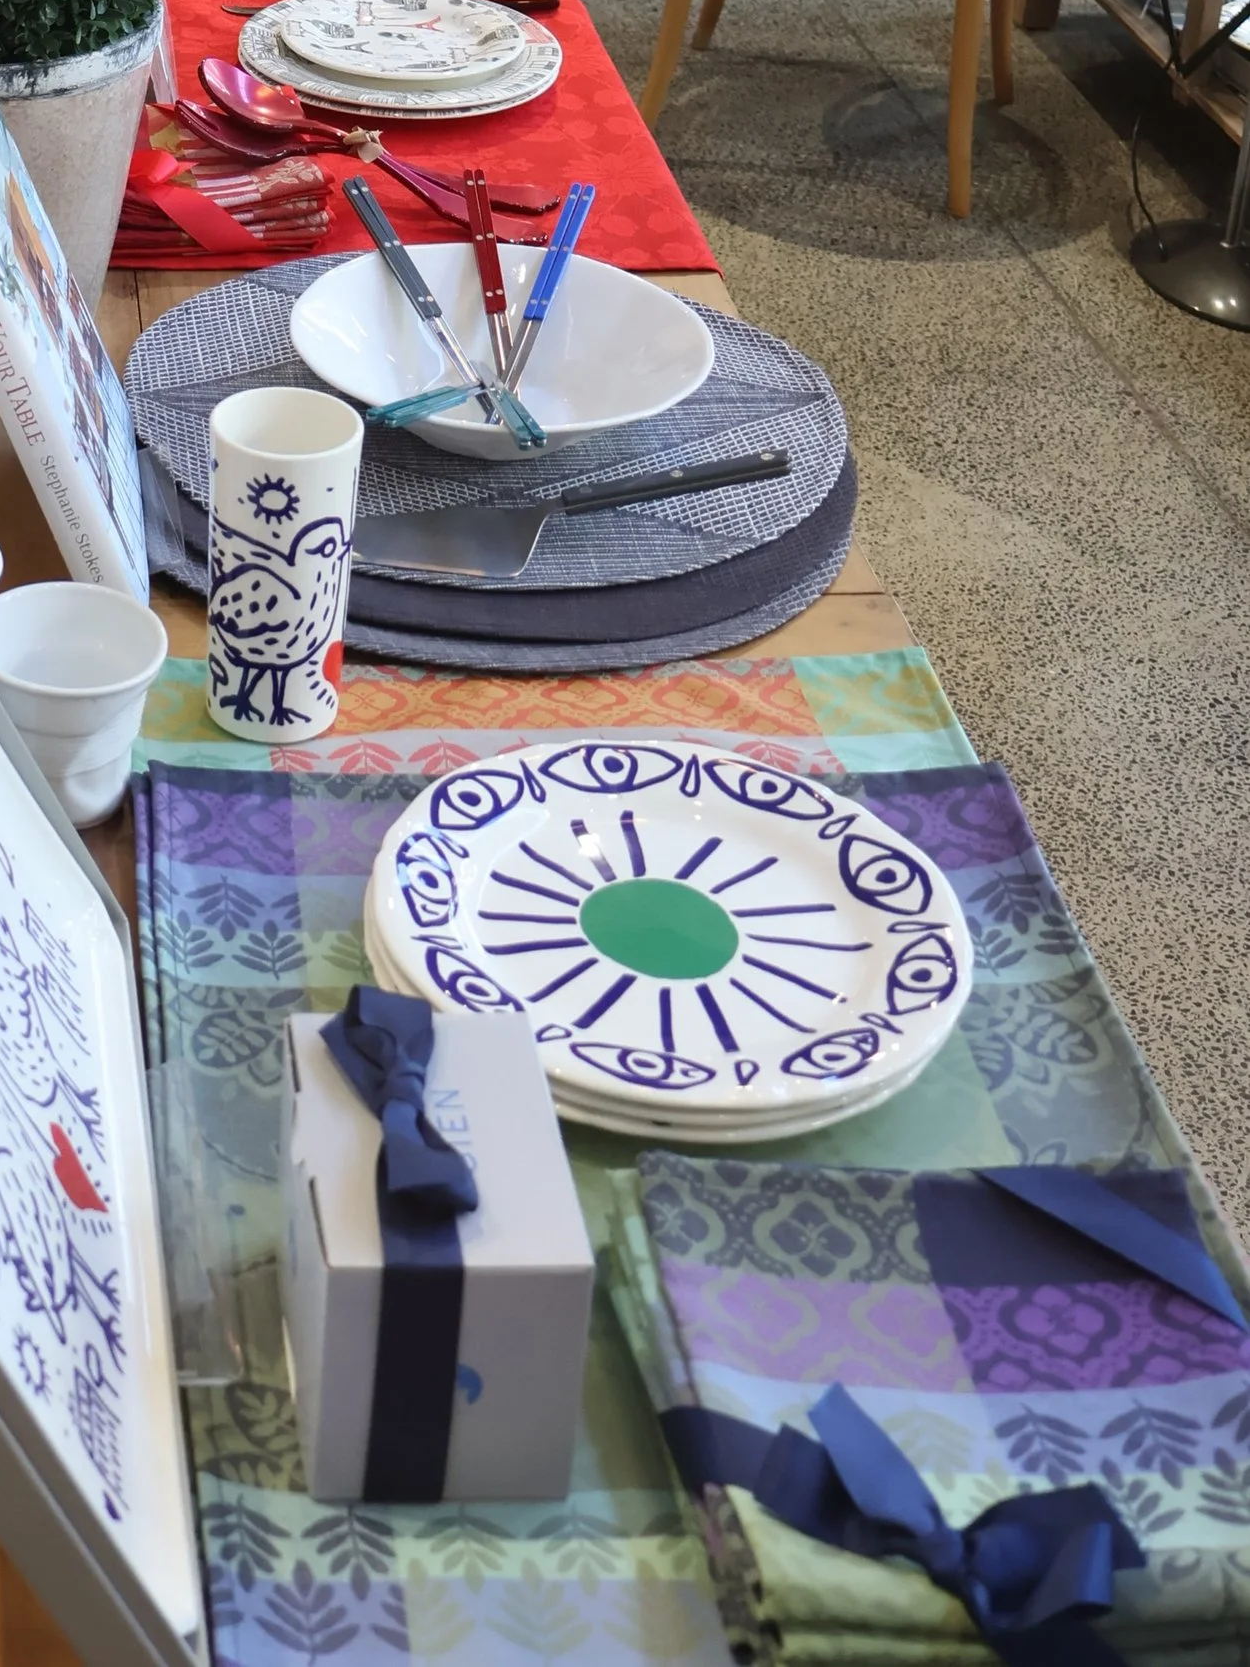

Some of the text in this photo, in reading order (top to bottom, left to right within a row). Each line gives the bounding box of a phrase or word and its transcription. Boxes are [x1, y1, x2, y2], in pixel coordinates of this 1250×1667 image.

[39, 454, 82, 531] Stephanie
[75, 532, 105, 584] Stokes
[429, 1088, 478, 1170] IEN
